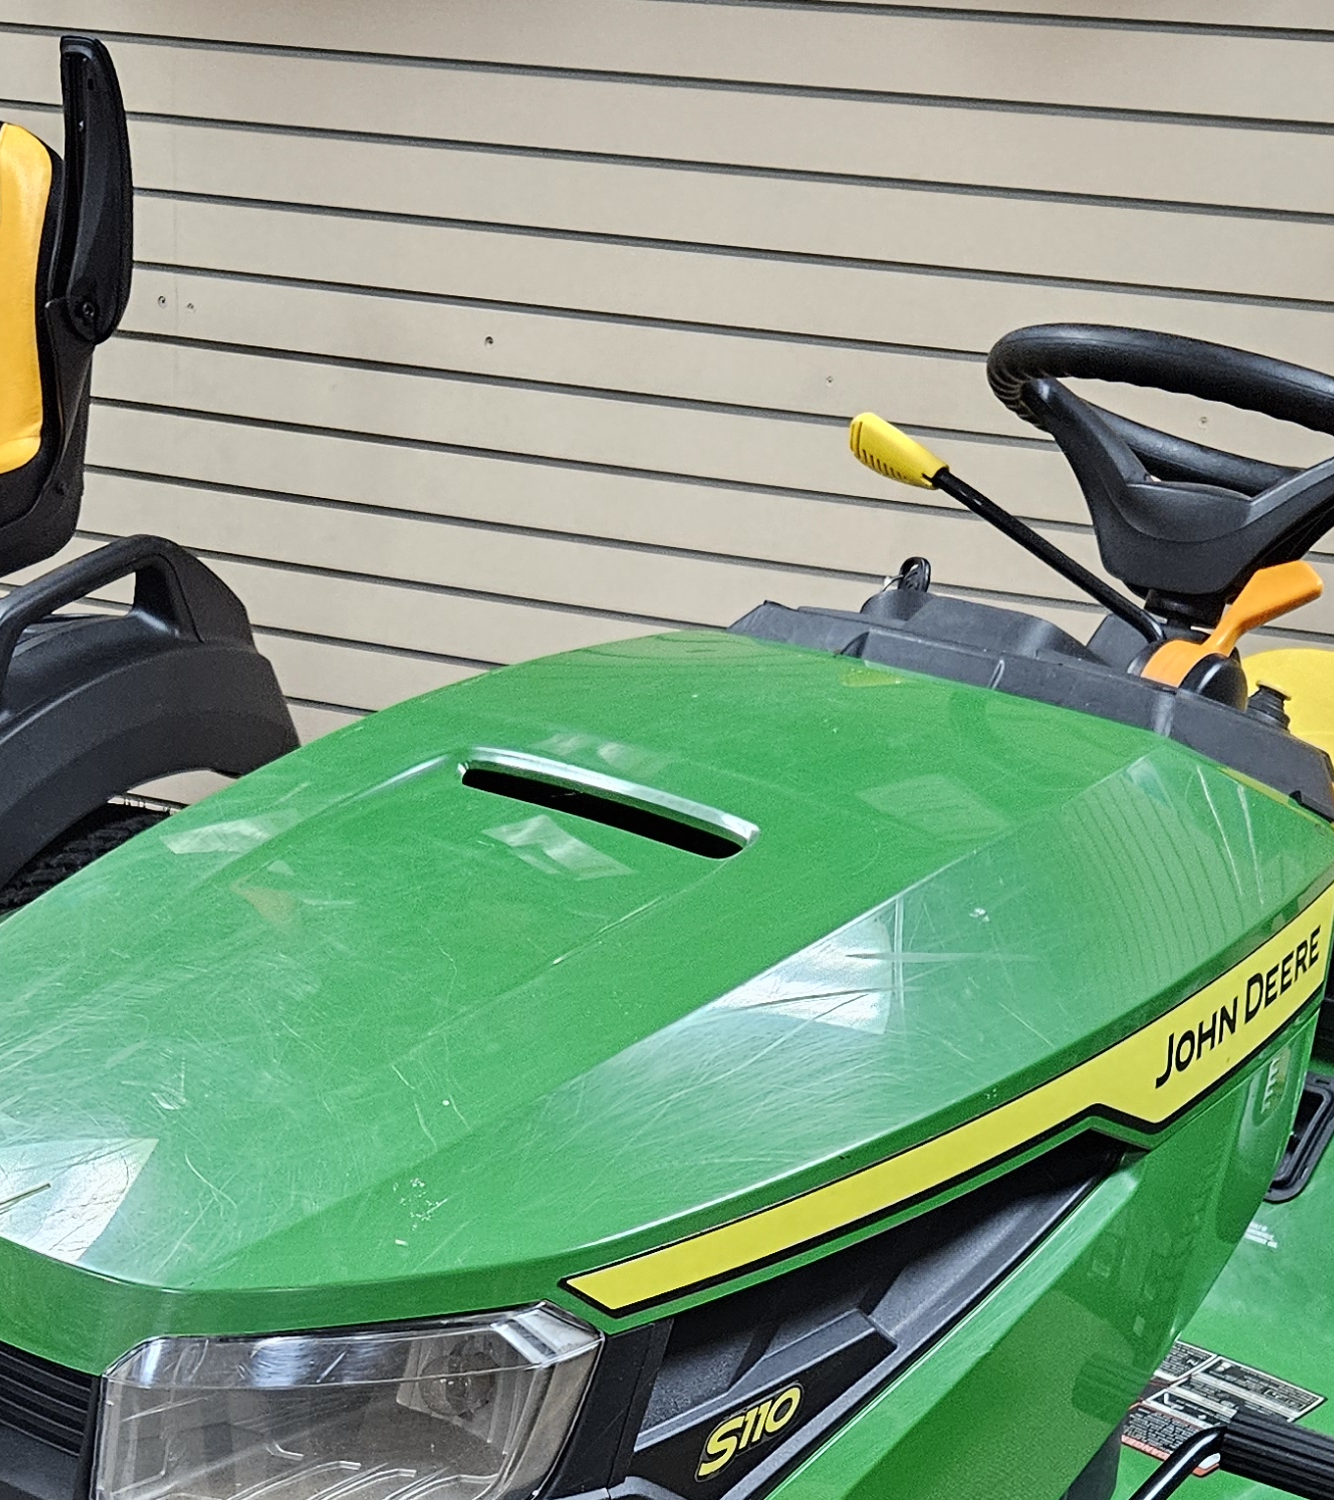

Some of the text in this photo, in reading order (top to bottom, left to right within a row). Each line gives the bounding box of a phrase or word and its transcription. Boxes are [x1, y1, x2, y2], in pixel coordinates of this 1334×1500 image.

[1155, 924, 1322, 1089] JOHN DEERE
[698, 1387, 801, 1477] S110
